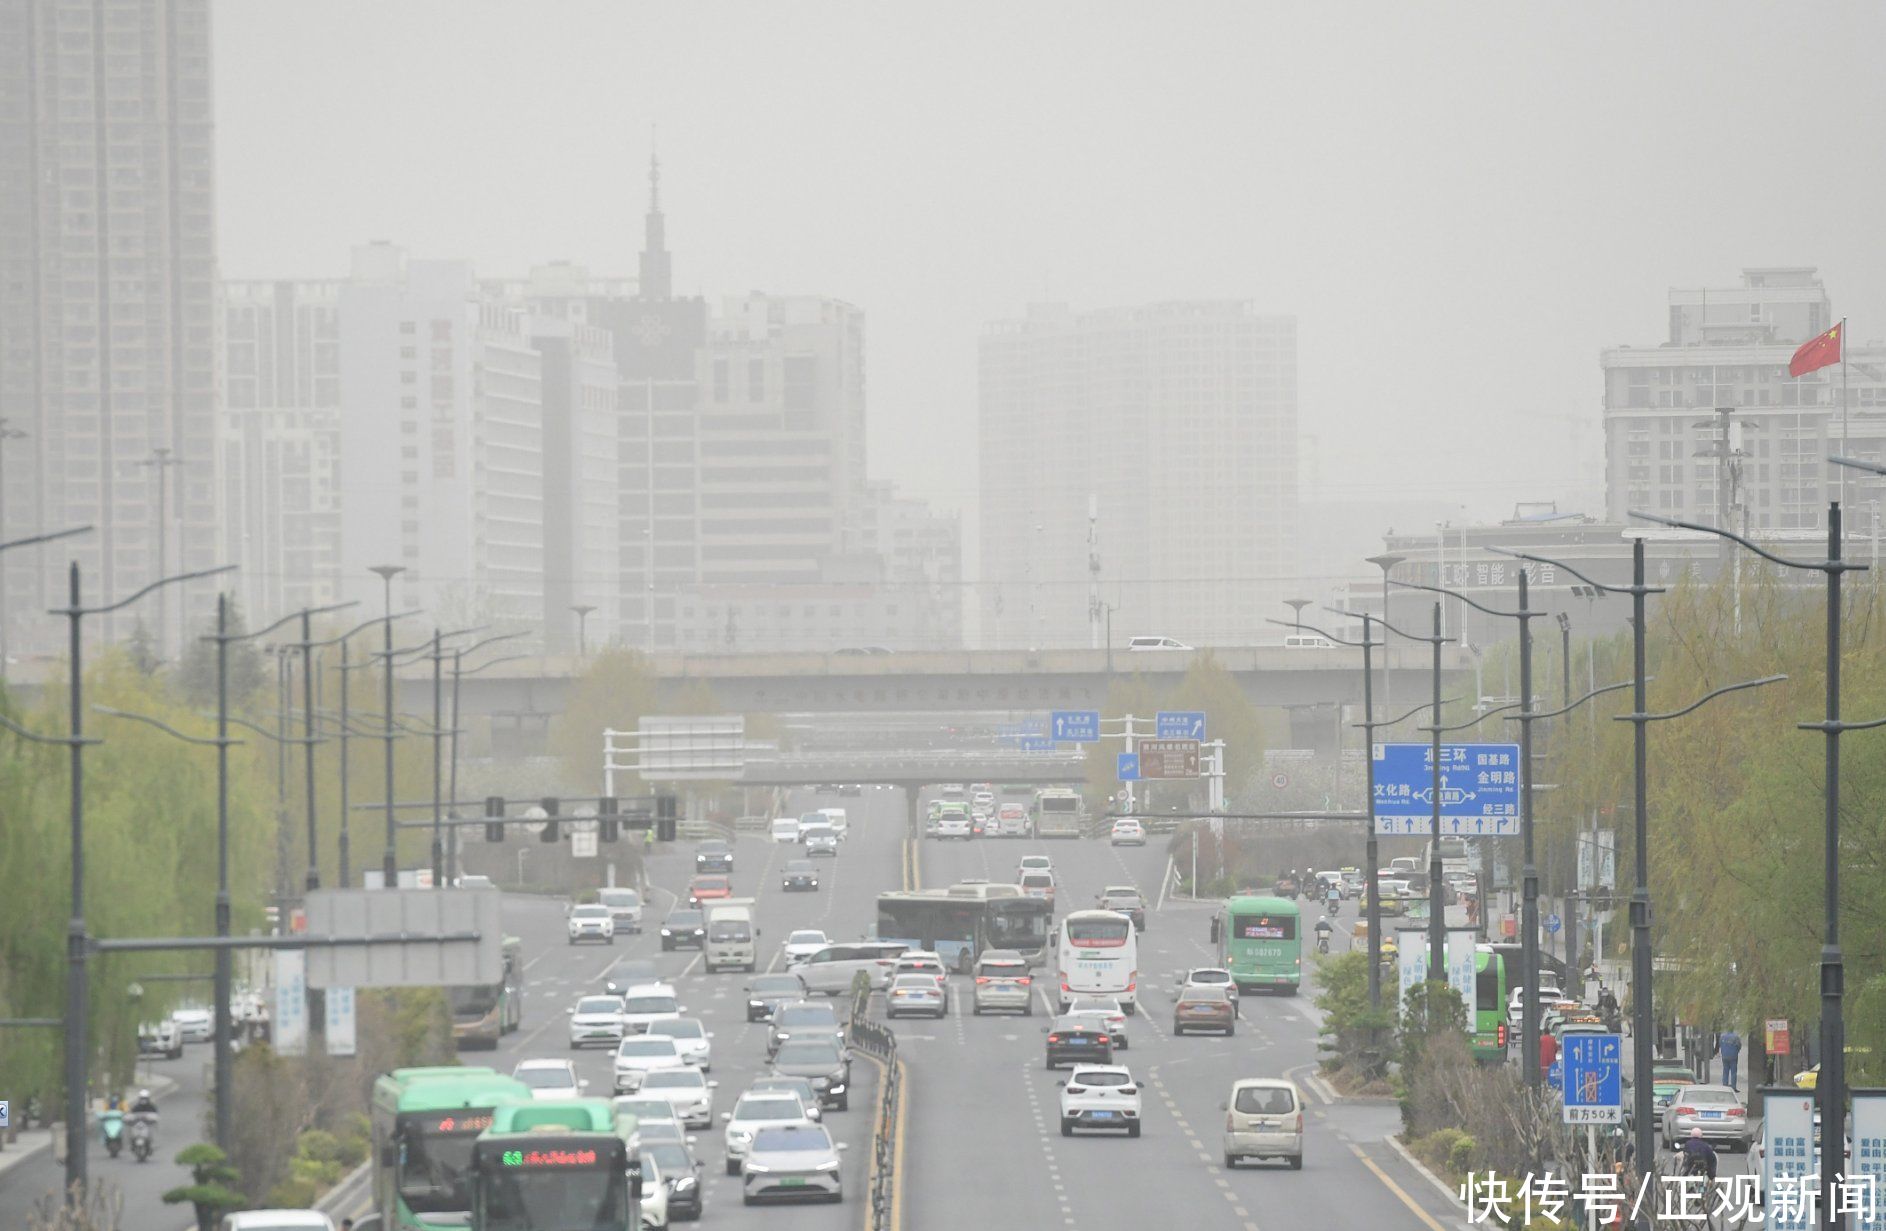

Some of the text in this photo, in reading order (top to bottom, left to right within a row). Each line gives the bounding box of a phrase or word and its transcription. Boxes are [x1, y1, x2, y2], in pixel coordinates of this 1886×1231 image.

[1477, 563, 1504, 585] 智能
[1424, 748, 1467, 762] 北三环
[1477, 754, 1510, 766] 国基路
[1477, 771, 1516, 785] 金明路
[1374, 784, 1411, 797] 文化路
[1482, 804, 1515, 815] 经三路
[1569, 1108, 1617, 1121] 前方50米
